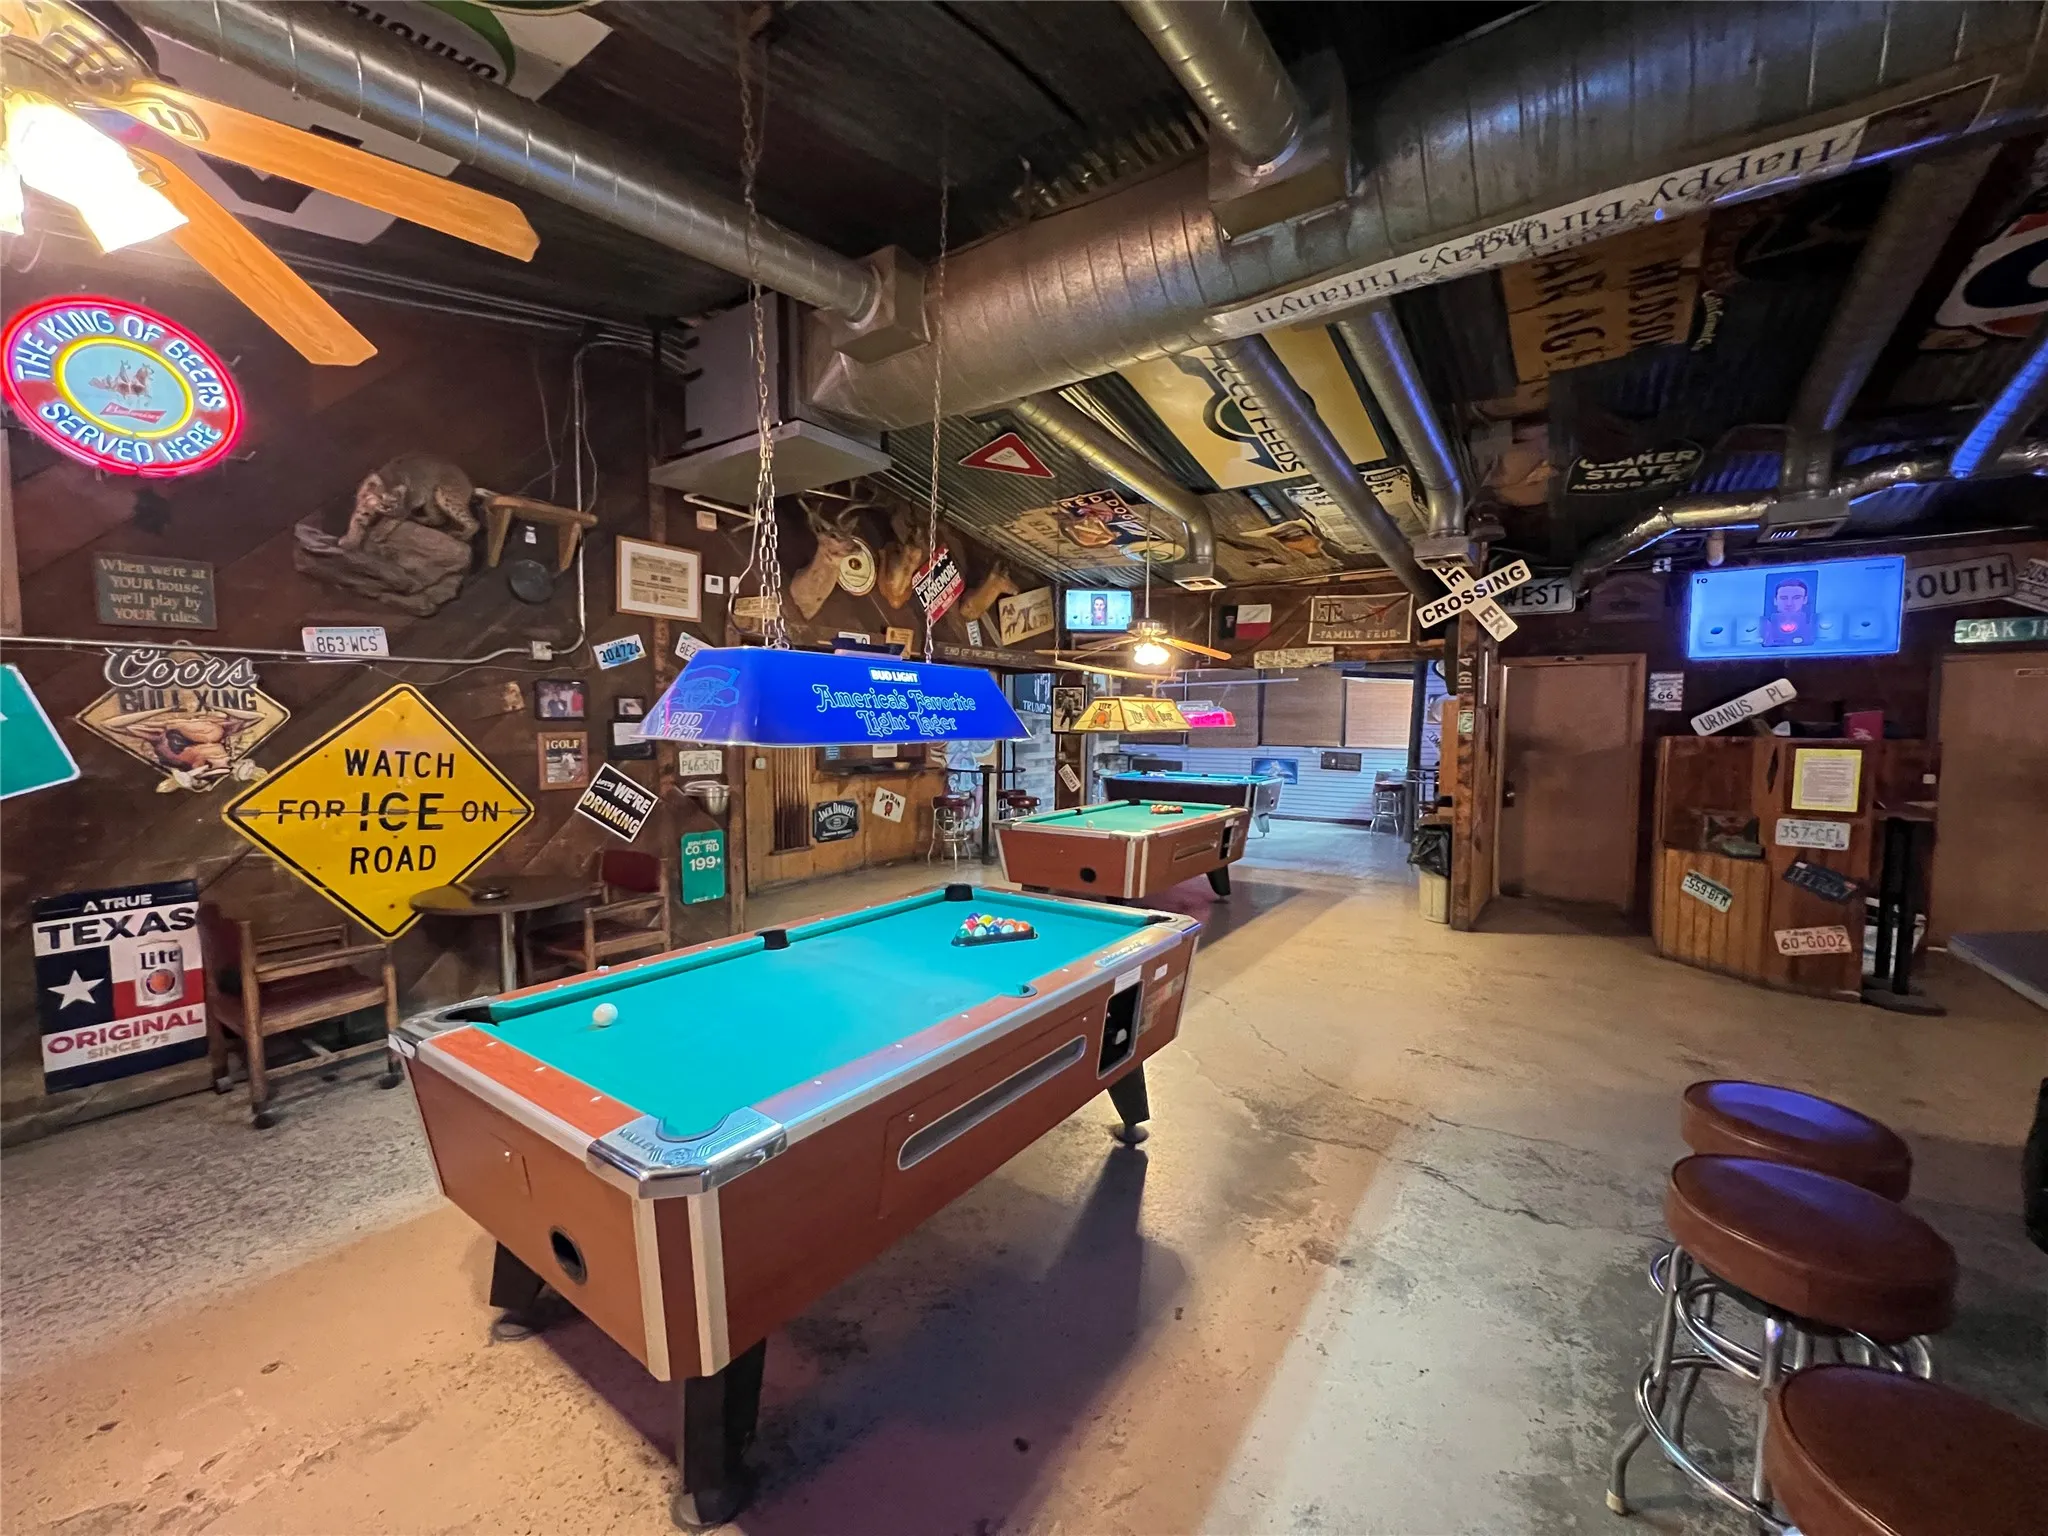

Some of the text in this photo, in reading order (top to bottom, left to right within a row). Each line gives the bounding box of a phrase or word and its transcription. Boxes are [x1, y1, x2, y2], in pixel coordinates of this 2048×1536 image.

[1645, 136, 1848, 201] Happy
[16, 310, 227, 409] THE KING OF BEERS
[41, 402, 222, 463] SERVED HERE
[1585, 464, 1682, 480] STATE
[1571, 480, 1645, 491] MOTOR
[1061, 495, 1135, 520] RED DOG
[100, 558, 206, 580] When we're at
[110, 575, 205, 596] YOUR house,
[1422, 564, 1526, 624] CROSSING
[110, 591, 201, 611] we'll play by
[113, 607, 204, 624] YOUR rules.
[1967, 620, 2016, 639] OAK
[104, 646, 259, 687] Coors
[870, 669, 919, 683] BUD LIGHT
[119, 689, 257, 713] BULL XING
[812, 684, 976, 713] America's Favorite
[1023, 700, 1045, 714] TRUMP
[1657, 691, 1674, 700] 66
[669, 712, 703, 726] BUD
[1698, 686, 1790, 732] URANUS PL
[856, 710, 958, 737] Light Lager
[550, 739, 581, 751] GOLF
[344, 748, 455, 778] WATCH
[612, 781, 652, 815] WE'RE
[277, 792, 499, 832] FOR ICE ON
[582, 790, 641, 834] DRINKING
[818, 806, 834, 822] JACK
[706, 843, 720, 852] RD
[349, 845, 437, 875] ROAD
[83, 893, 153, 913] A TRUE
[37, 906, 199, 950] TEXAS
[139, 949, 181, 970] Lite
[47, 1010, 203, 1054] ORIGINAL
[87, 1037, 143, 1059] SINCE
